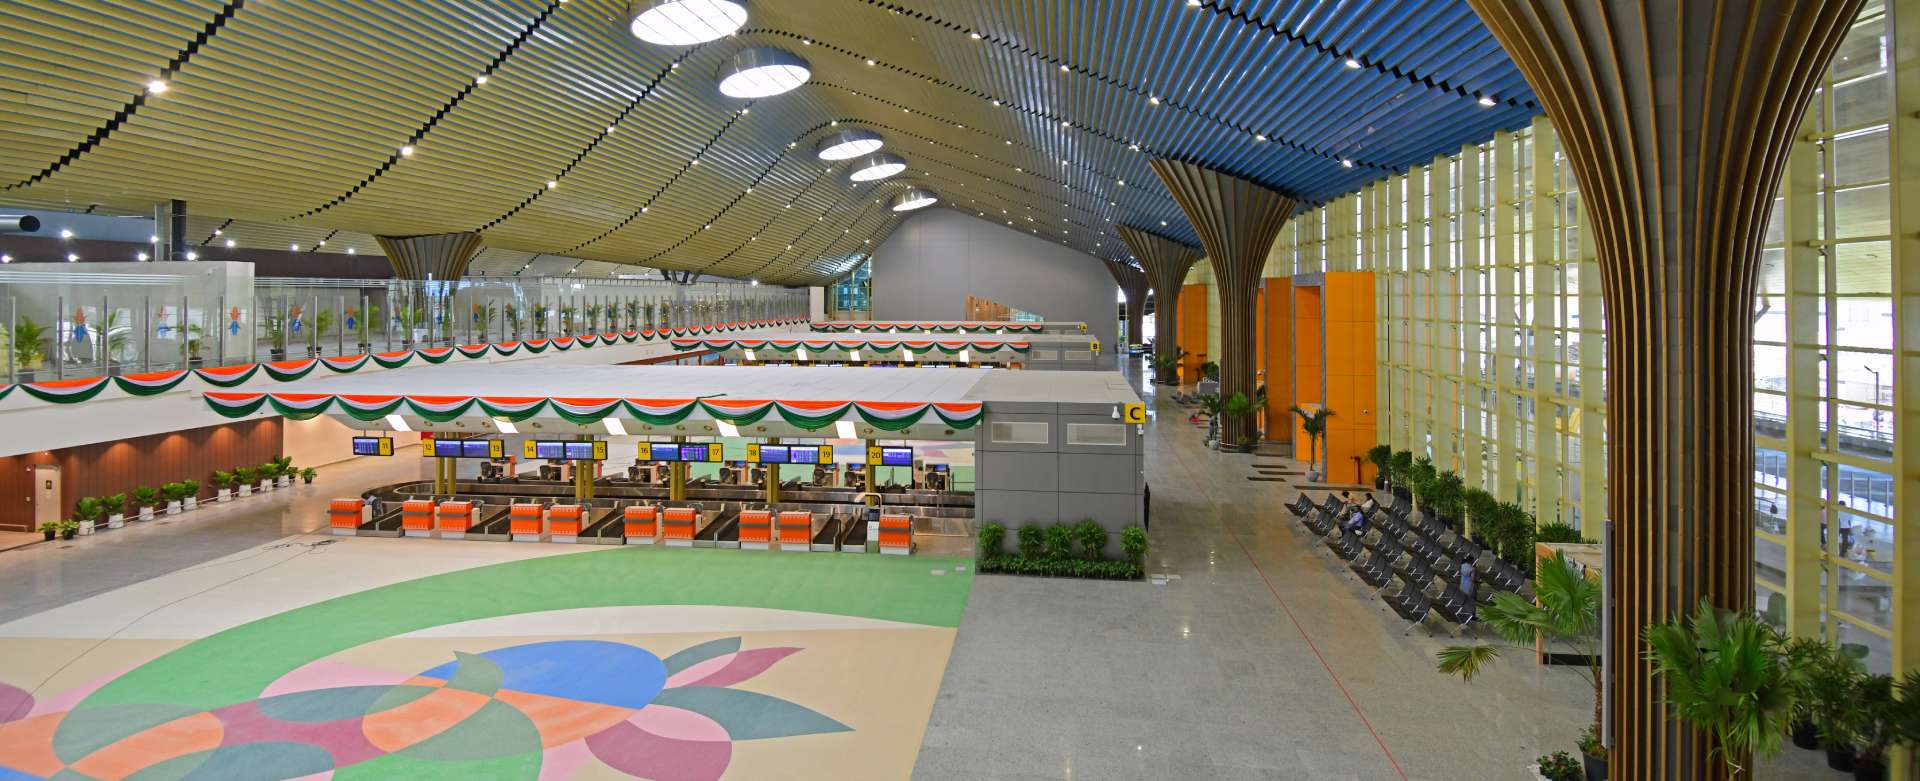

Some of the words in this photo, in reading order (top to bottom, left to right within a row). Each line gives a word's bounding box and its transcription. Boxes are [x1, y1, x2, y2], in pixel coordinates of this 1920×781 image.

[1130, 407, 1141, 420] C
[382, 442, 388, 450] 11
[424, 443, 432, 451] 12
[493, 444, 500, 452] 13
[526, 445, 534, 453] 14
[596, 446, 604, 454] 15
[640, 447, 648, 455] 16
[712, 448, 719, 456] 17
[749, 449, 757, 457] 18
